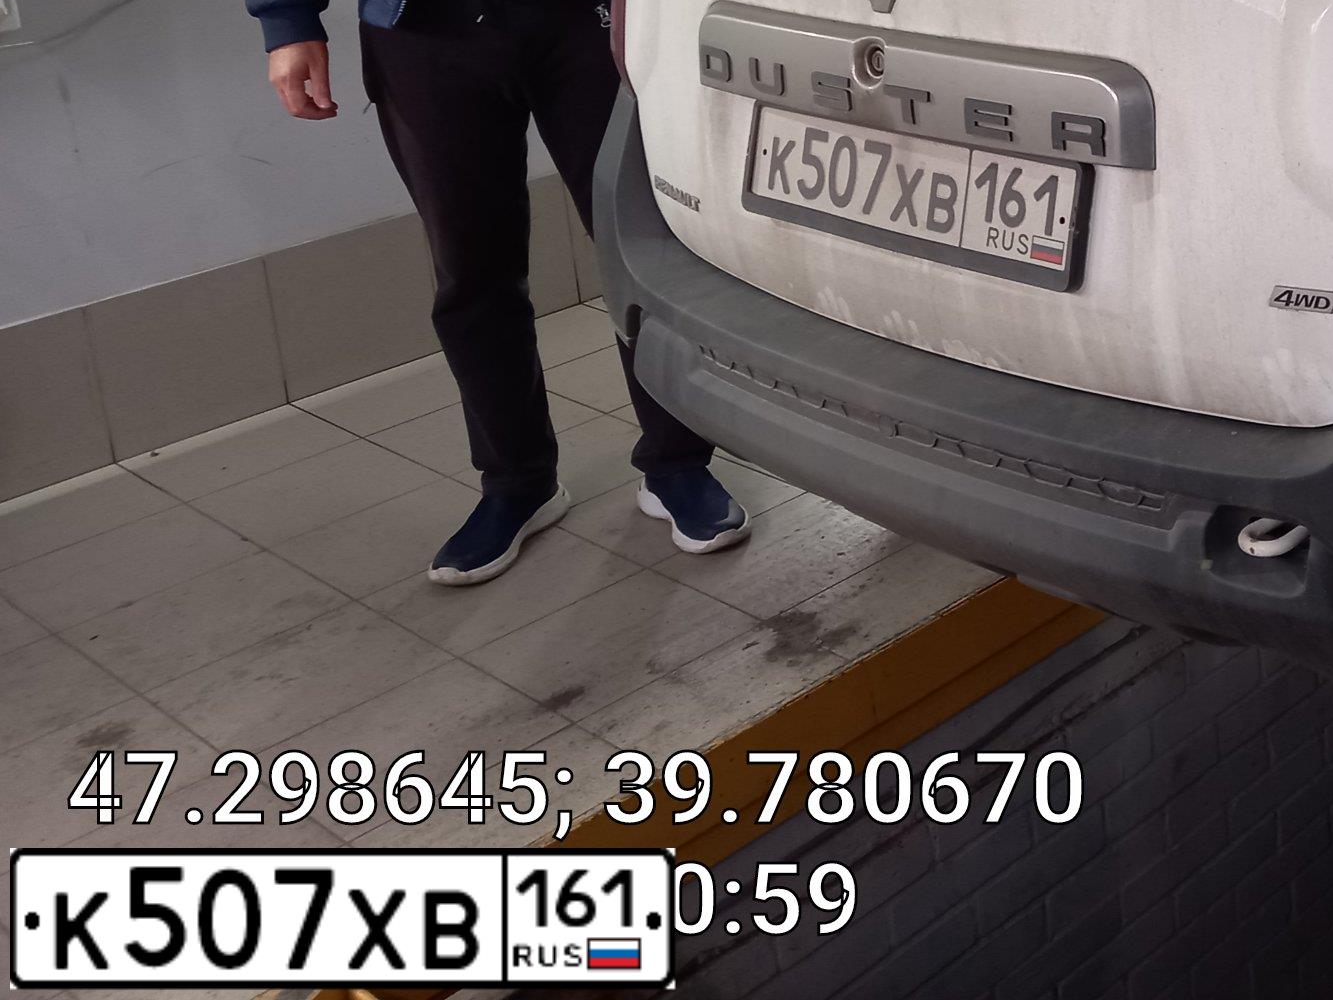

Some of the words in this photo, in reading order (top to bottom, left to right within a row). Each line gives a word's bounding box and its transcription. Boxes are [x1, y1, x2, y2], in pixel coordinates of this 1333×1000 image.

[701, 44, 1106, 157] DUSTER
[974, 161, 1060, 236] 161
[986, 226, 1029, 256] RUS
[1274, 289, 1331, 310] 4WD
